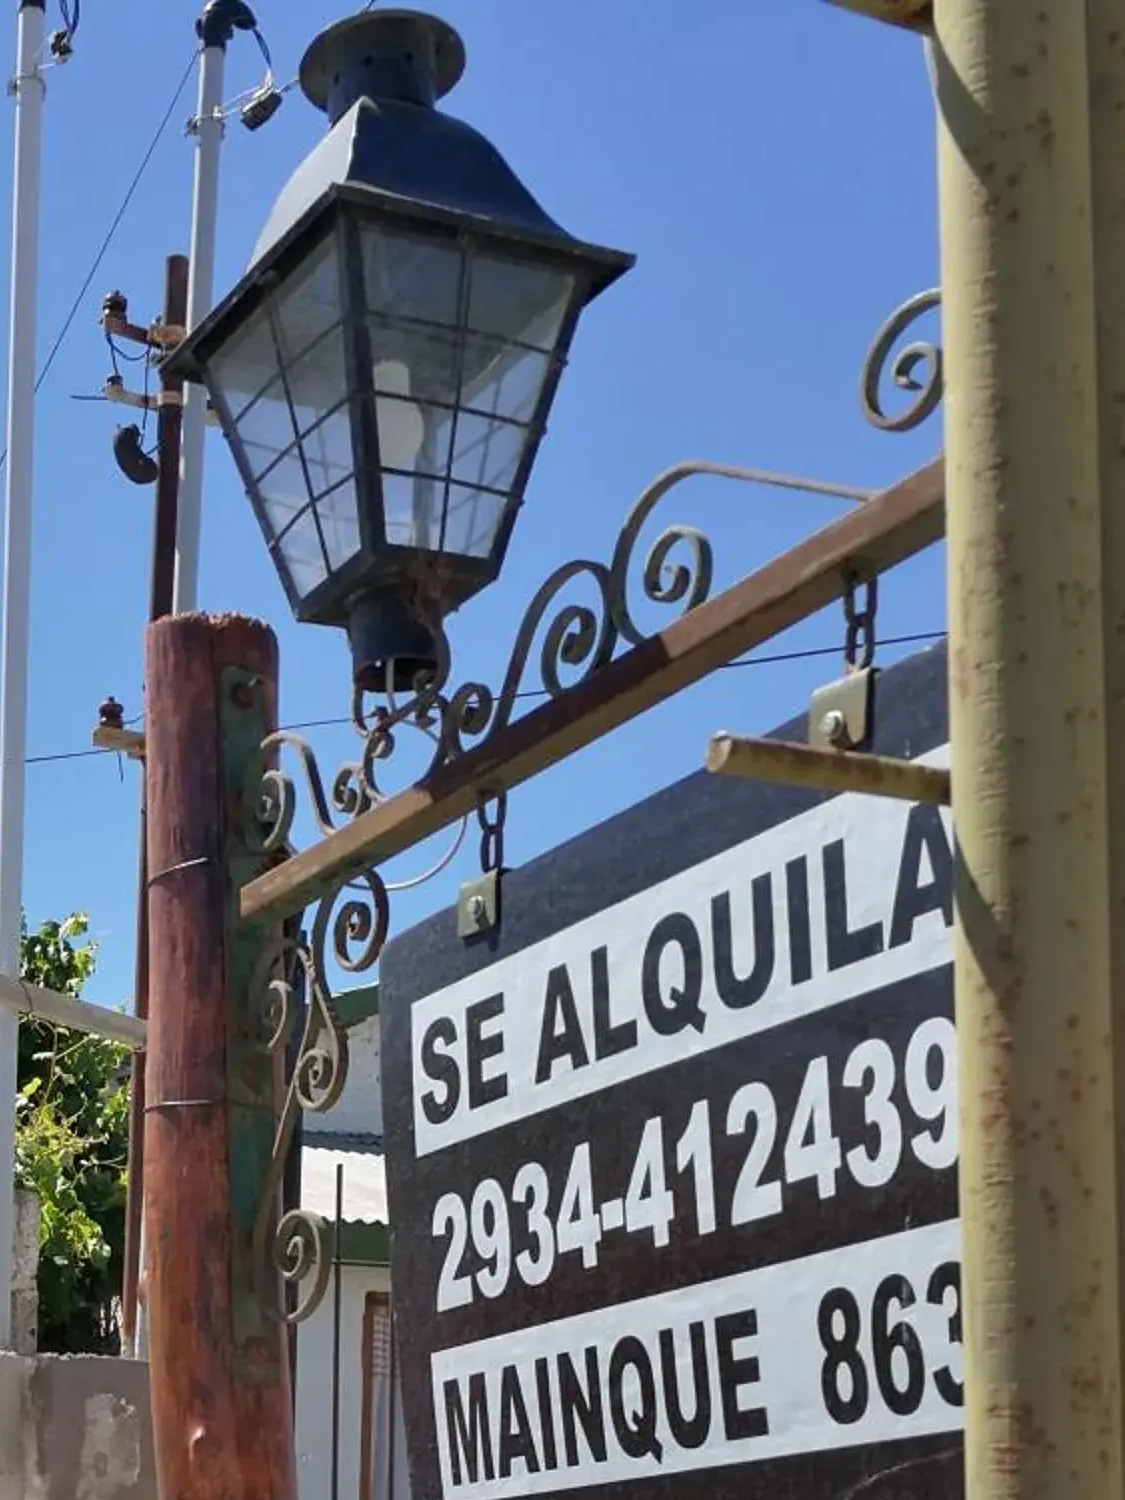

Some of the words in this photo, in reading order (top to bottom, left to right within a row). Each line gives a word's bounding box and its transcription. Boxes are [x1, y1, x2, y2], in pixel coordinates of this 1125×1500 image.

[420, 991, 509, 1127] SE
[535, 802, 954, 1085] ALQUILA
[432, 1016, 958, 1313] 2934-412439
[442, 1307, 770, 1487] MAINQUE
